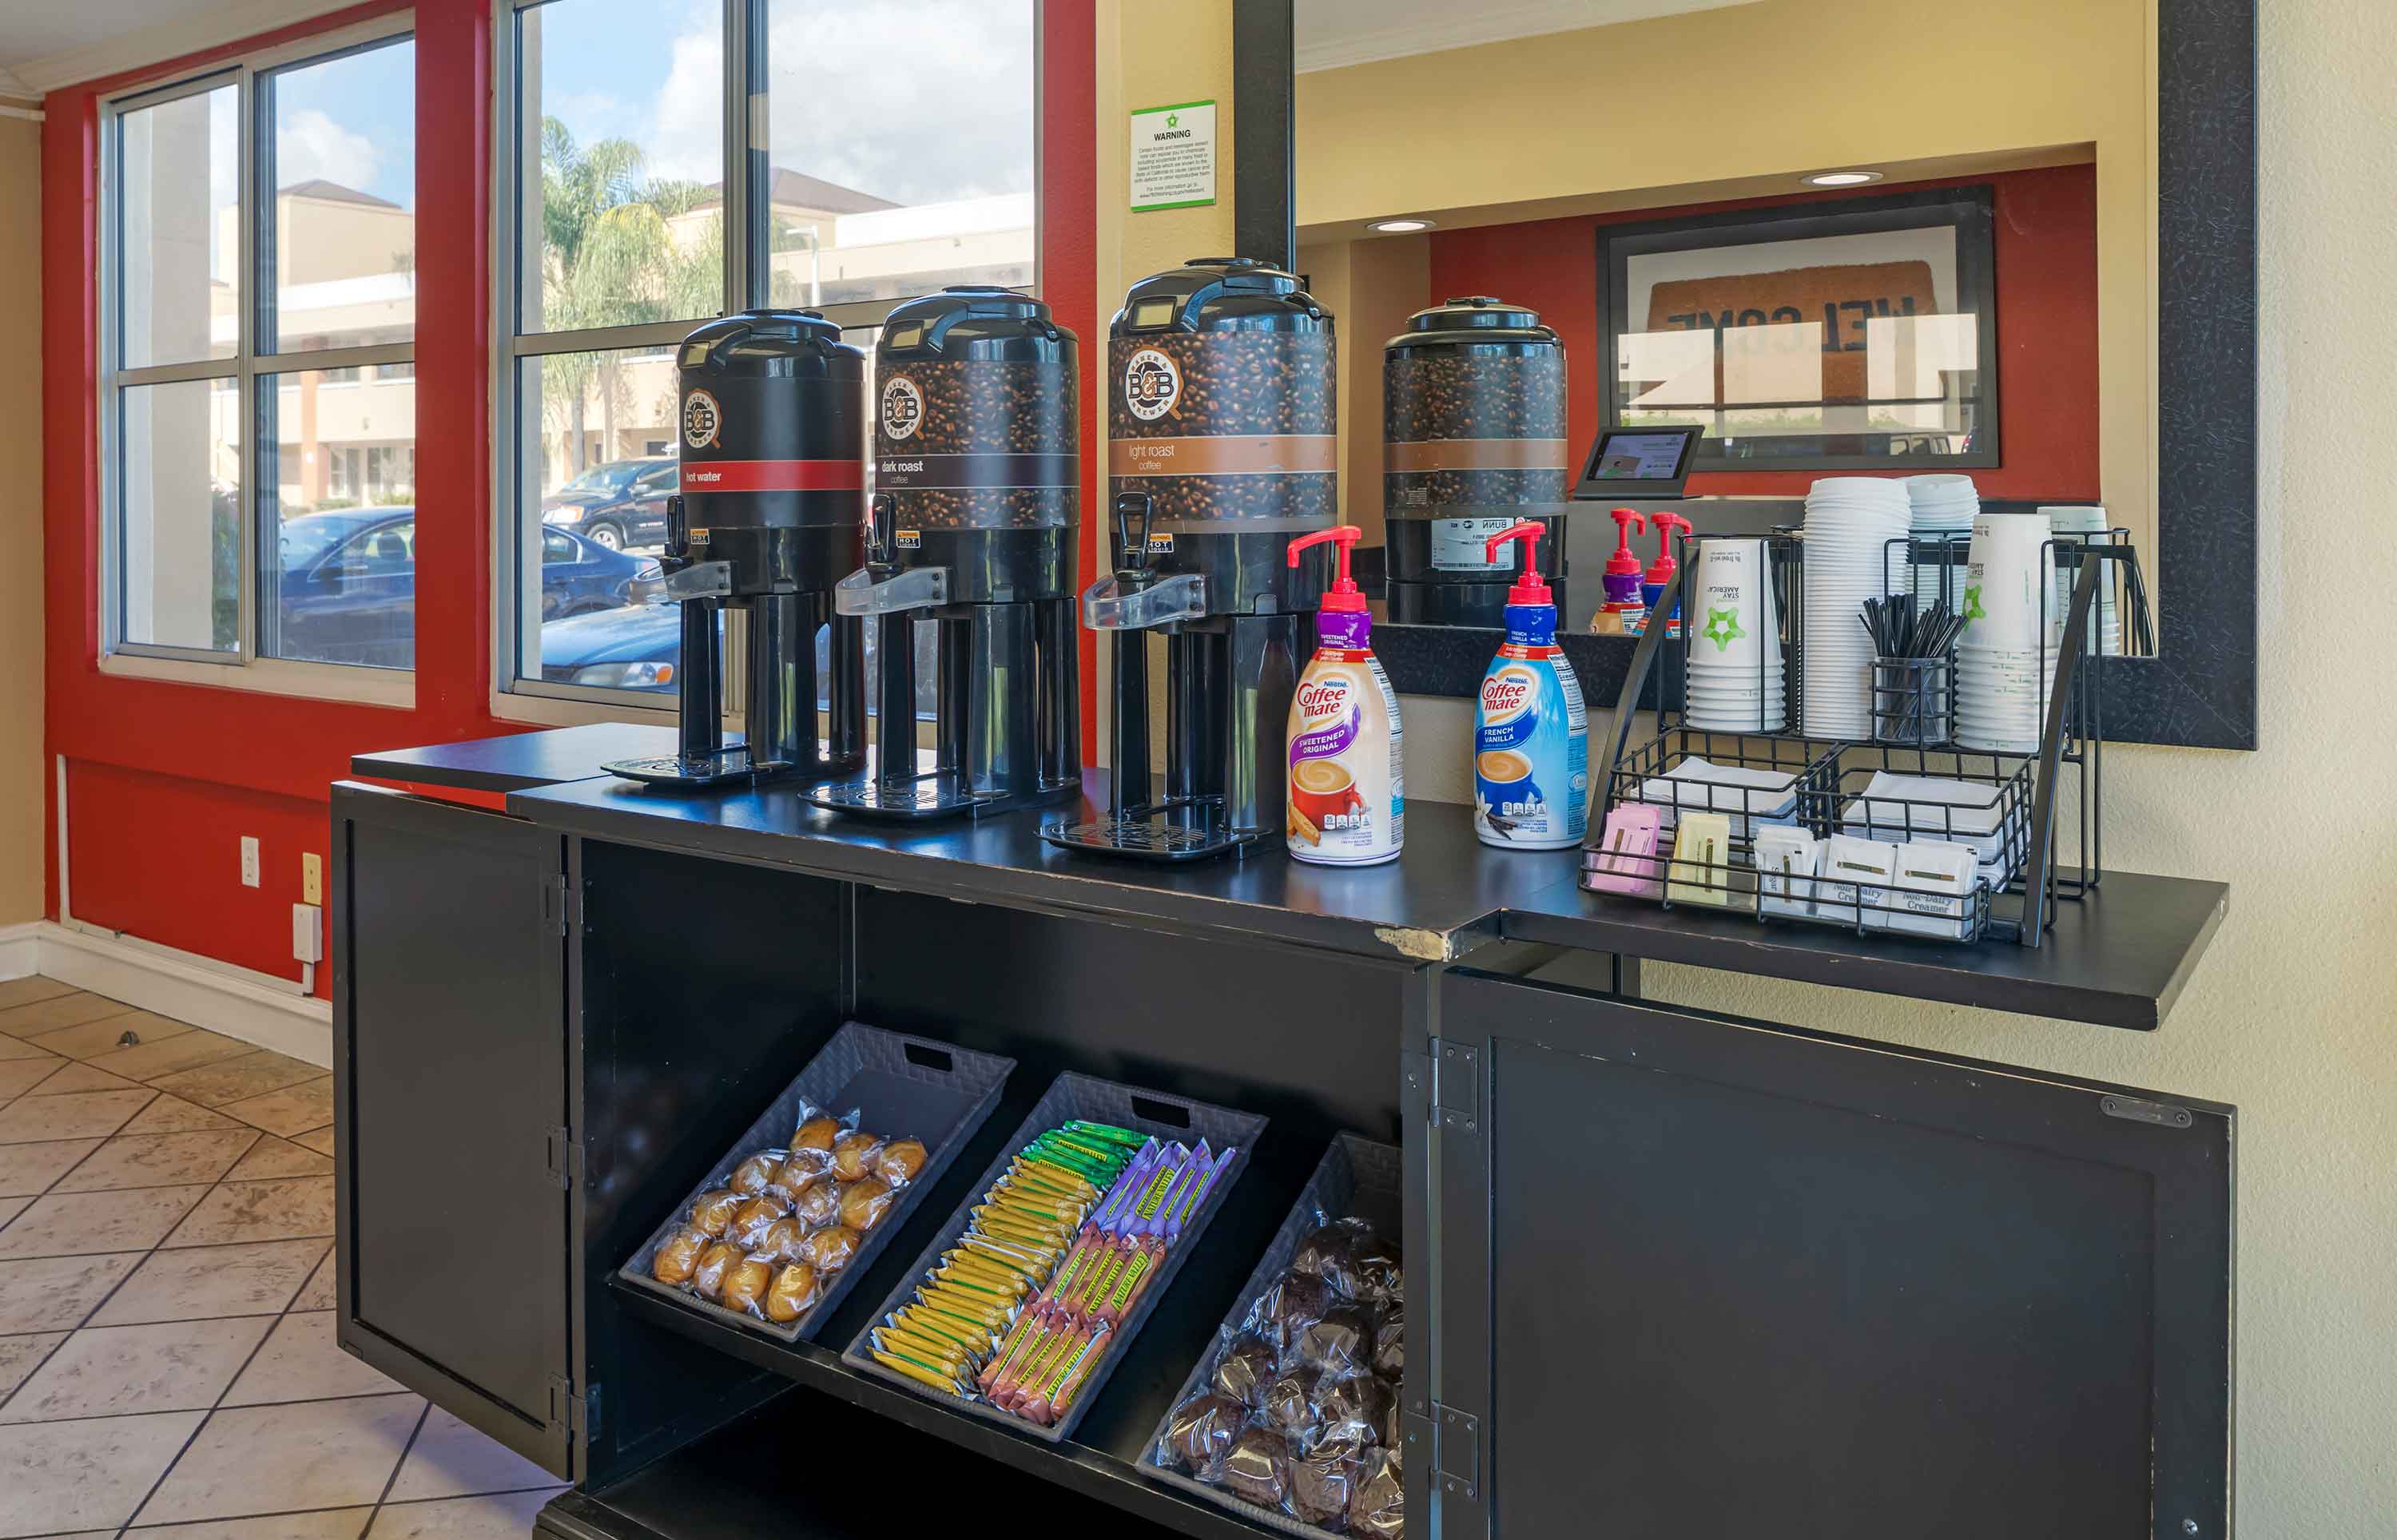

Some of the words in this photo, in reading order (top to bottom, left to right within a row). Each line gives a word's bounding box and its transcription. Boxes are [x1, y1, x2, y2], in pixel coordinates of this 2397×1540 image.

[1154, 129, 1191, 141] WARNING
[1128, 372, 1174, 399] B&B
[884, 397, 918, 421] B&B
[686, 410, 714, 431] B&B
[1149, 445, 1175, 456] roast
[882, 461, 896, 472] dark
[898, 461, 924, 472] roast
[1138, 460, 1162, 470] coffee
[686, 472, 696, 482] hot
[697, 471, 722, 482] water
[1297, 682, 1346, 707] Coffee
[1482, 677, 1526, 701] Coffee
[1304, 702, 1340, 717] mate
[1485, 698, 1520, 710] mate
[1298, 729, 1345, 748] SWEETENED
[1484, 726, 1514, 736] FRENCH
[1485, 733, 1514, 743] VANILLA
[1303, 741, 1339, 753] ORIGINAL
[1770, 866, 1779, 891] Sgar
[1907, 900, 1950, 914] Creamer
[1143, 1192, 1162, 1218] NATURE
[1155, 1168, 1175, 1196] VALLEY
[1088, 1284, 1110, 1313] NATURE
[1103, 1260, 1124, 1288] VALLEY
[1111, 1276, 1135, 1306] NATURE
[1127, 1255, 1147, 1280] VALLEY
[1045, 1367, 1068, 1397] NATURE
[1063, 1343, 1086, 1371] VALLEY
